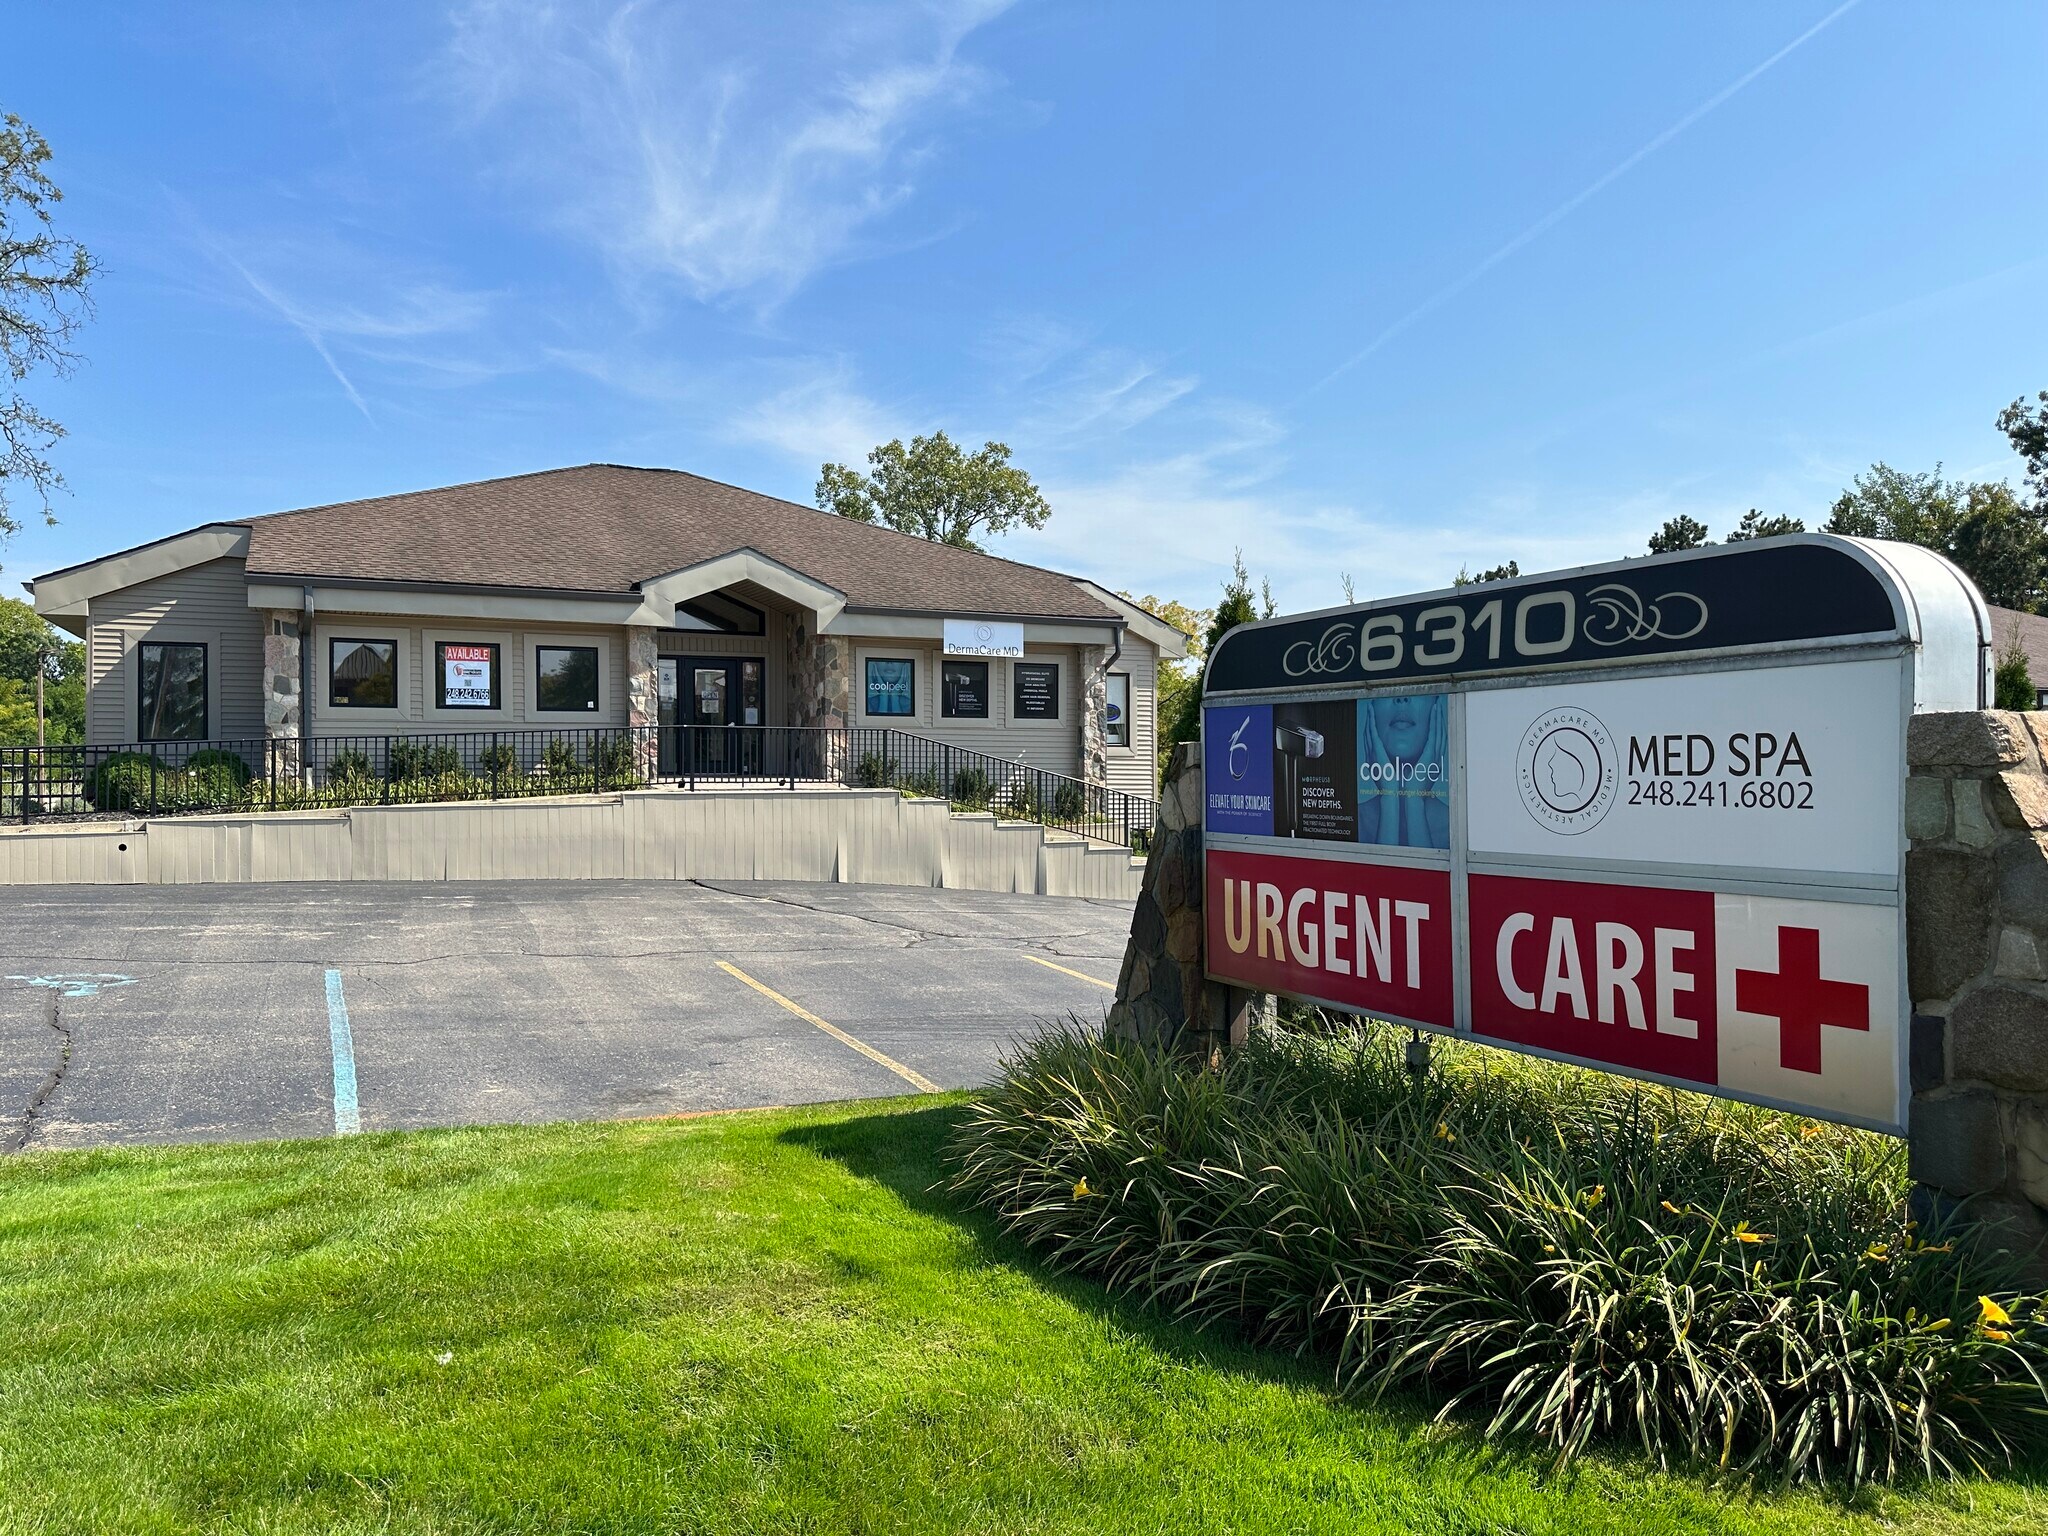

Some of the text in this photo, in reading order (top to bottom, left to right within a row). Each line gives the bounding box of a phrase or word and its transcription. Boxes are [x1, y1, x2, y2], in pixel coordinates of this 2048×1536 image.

[1359, 590, 1576, 672] 6310
[447, 648, 489, 660] AVAILABLE
[948, 643, 1019, 656] DermaCare MD
[870, 681, 908, 693] coolpeel
[1528, 716, 1605, 746] DERMACARE MD
[1628, 732, 1812, 777] MED SPA
[1360, 756, 1444, 787] coolpeel
[1210, 794, 1271, 811] ELEVATE YOUR SKINCARE
[1302, 788, 1334, 797] DISCOVER
[1302, 799, 1342, 809] NEW DEPTHS.
[1523, 774, 1612, 824] MEDICAL AESTHETICS
[1628, 780, 1814, 809] 248.241.6802
[1224, 878, 1699, 1040] URGENT CARE
